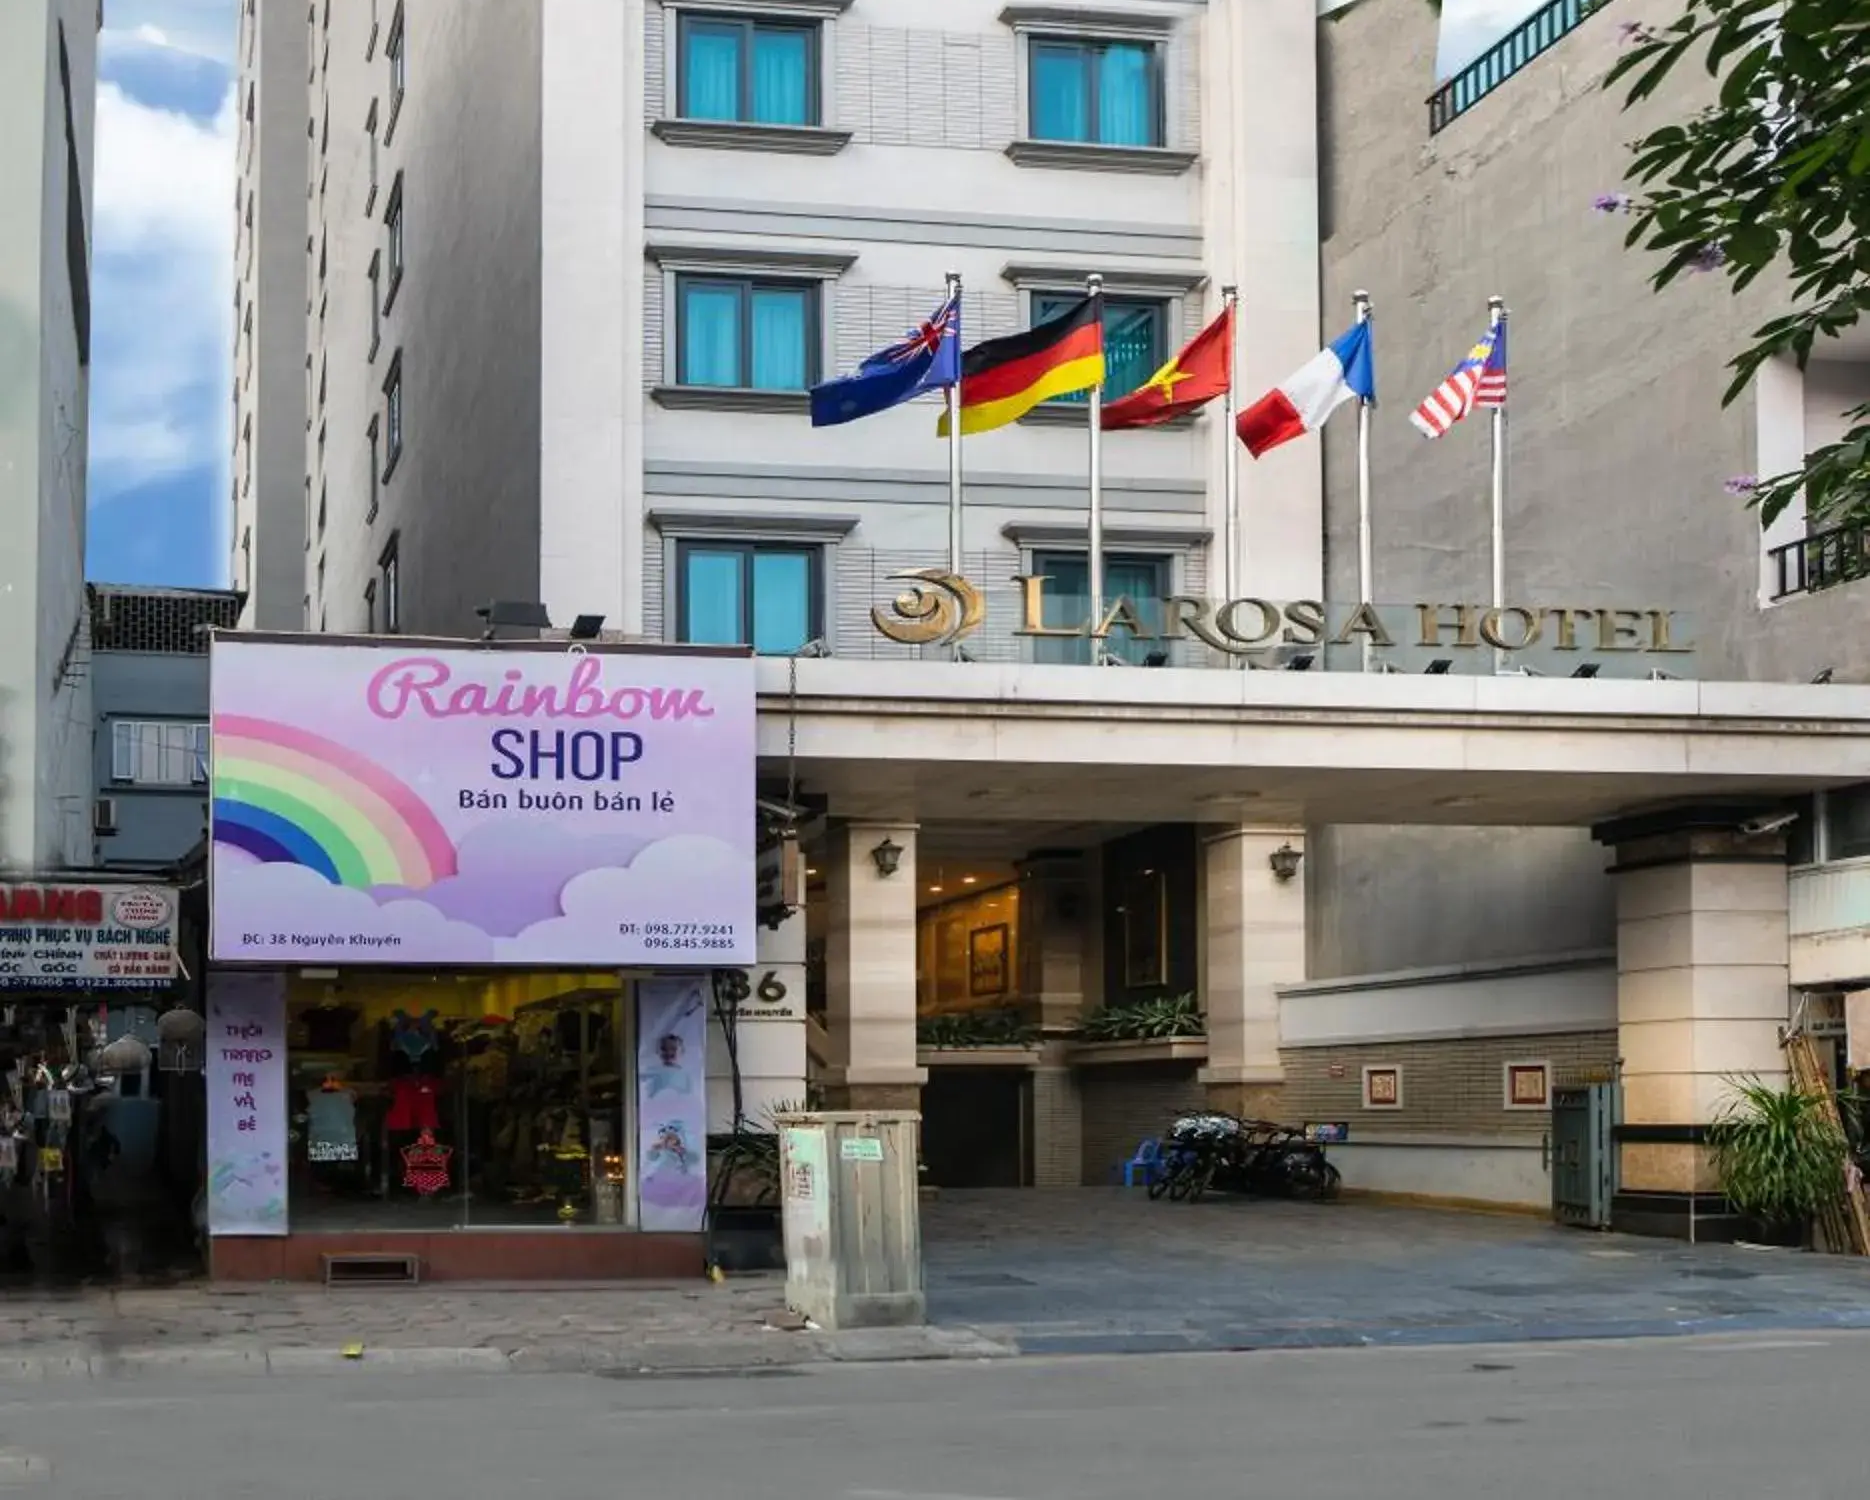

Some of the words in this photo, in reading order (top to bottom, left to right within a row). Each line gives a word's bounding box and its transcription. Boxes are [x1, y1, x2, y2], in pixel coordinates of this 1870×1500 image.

[1011, 575, 1397, 654] LAROSA
[1415, 603, 1695, 652] HOTEL
[367, 657, 715, 720] Rainbow
[491, 728, 643, 781] SHOP
[459, 788, 507, 809] Bán
[519, 788, 583, 811] buôn
[594, 789, 641, 811] bán
[269, 933, 287, 945] 38
